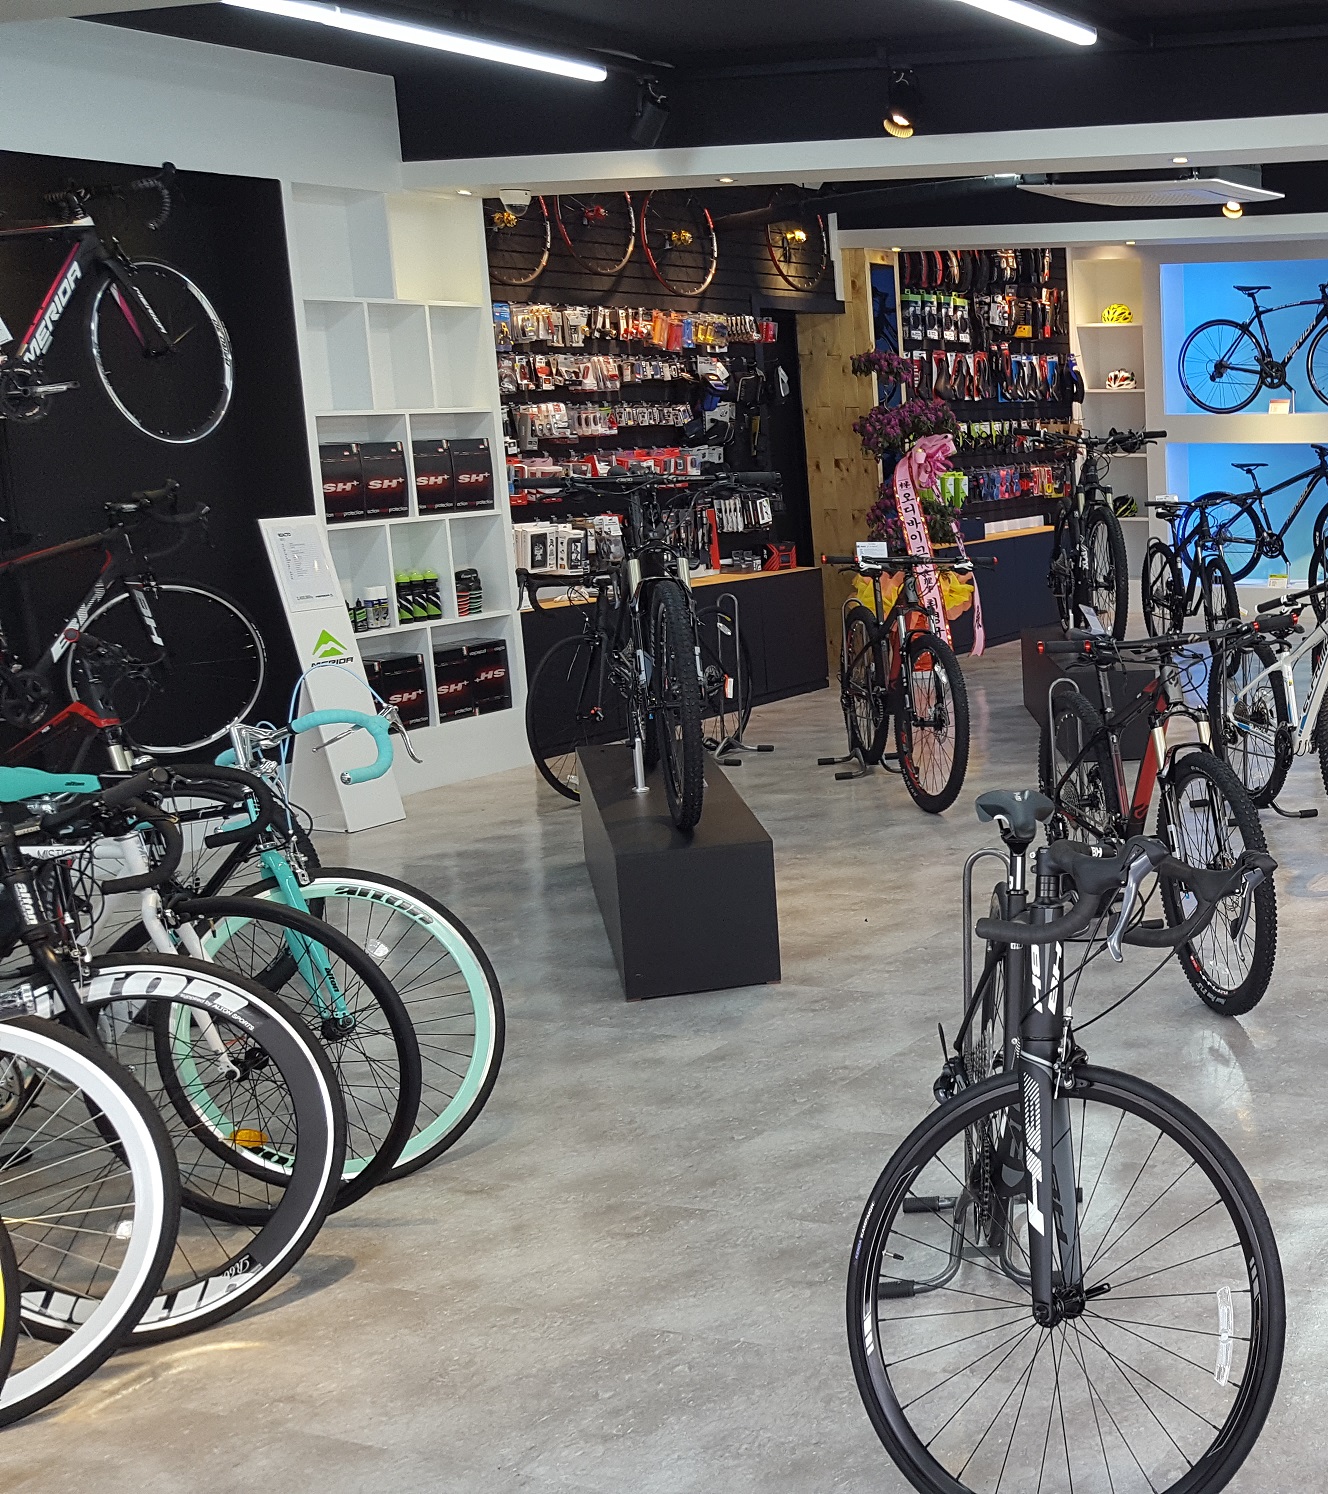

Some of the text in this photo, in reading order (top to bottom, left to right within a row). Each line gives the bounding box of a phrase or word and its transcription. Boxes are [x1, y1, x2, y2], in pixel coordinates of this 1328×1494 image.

[23, 260, 83, 363] MERIDA
[368, 477, 405, 490] SH+
[416, 474, 450, 486] SH+
[457, 471, 491, 484] SH+
[437, 680, 469, 695] SH+
[334, 886, 434, 926] alton
